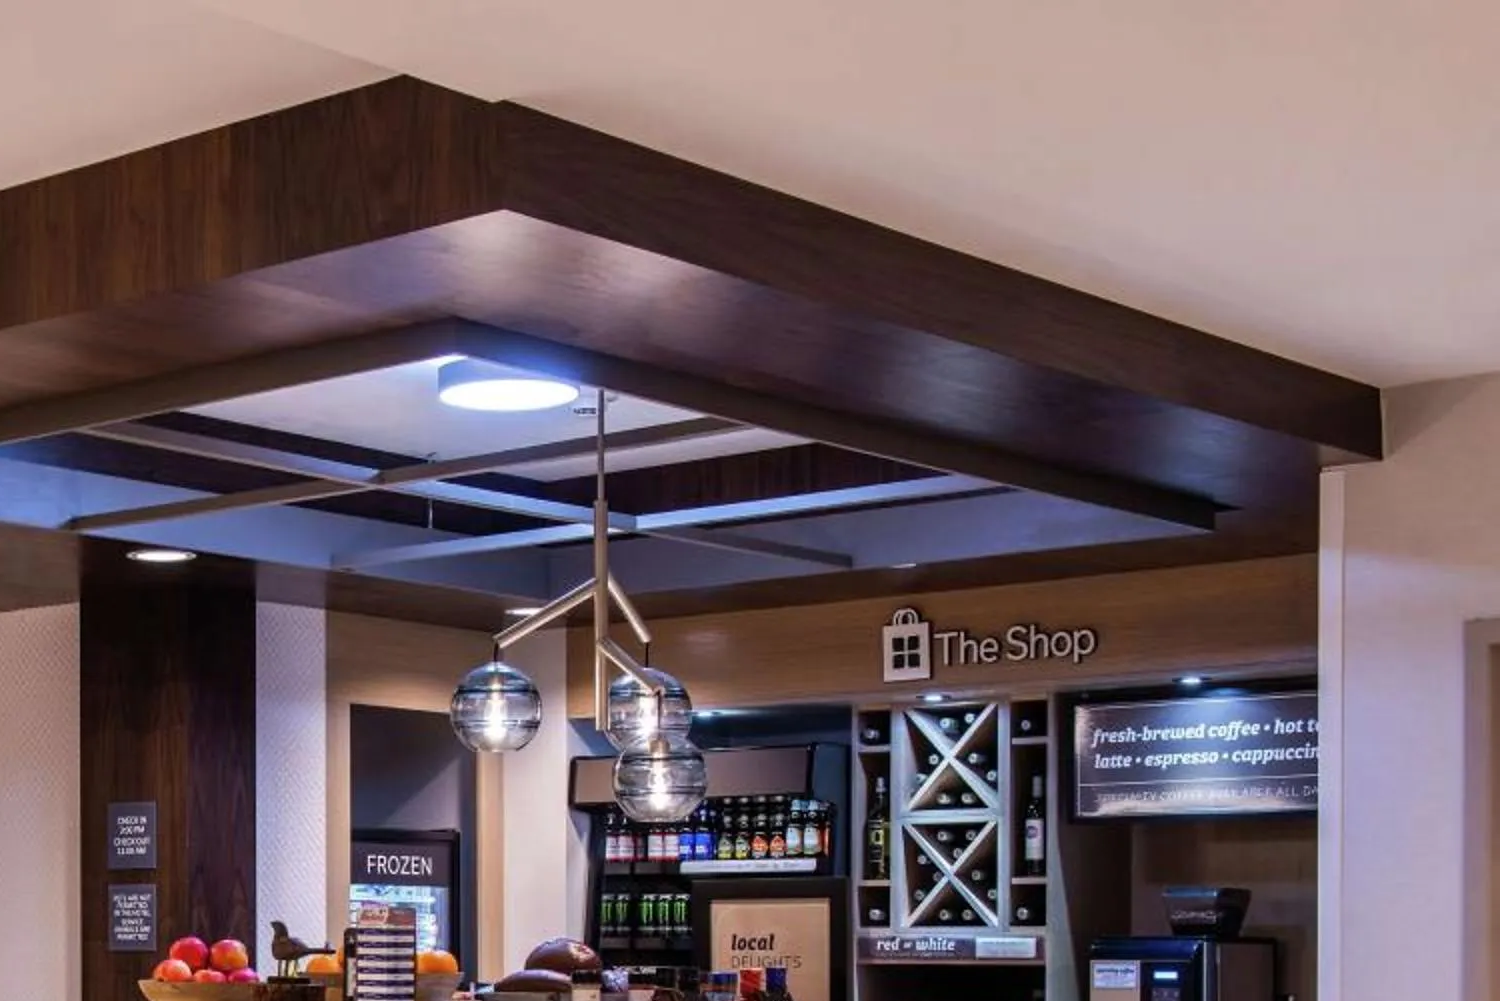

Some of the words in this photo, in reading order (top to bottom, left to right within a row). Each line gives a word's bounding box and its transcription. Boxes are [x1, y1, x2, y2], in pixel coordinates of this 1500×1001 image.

[933, 631, 999, 666] The
[1005, 623, 1096, 664] Shop
[1092, 724, 1205, 748] fresh-brewed
[1207, 719, 1261, 741] coffee
[1273, 717, 1304, 735] hot
[1094, 752, 1132, 769] latte
[1144, 750, 1219, 771] espresso
[366, 854, 433, 876] FROZEN
[731, 933, 775, 951] local
[876, 937, 900, 951] red
[915, 937, 956, 951] white
[731, 955, 802, 969] DELIGHTS
